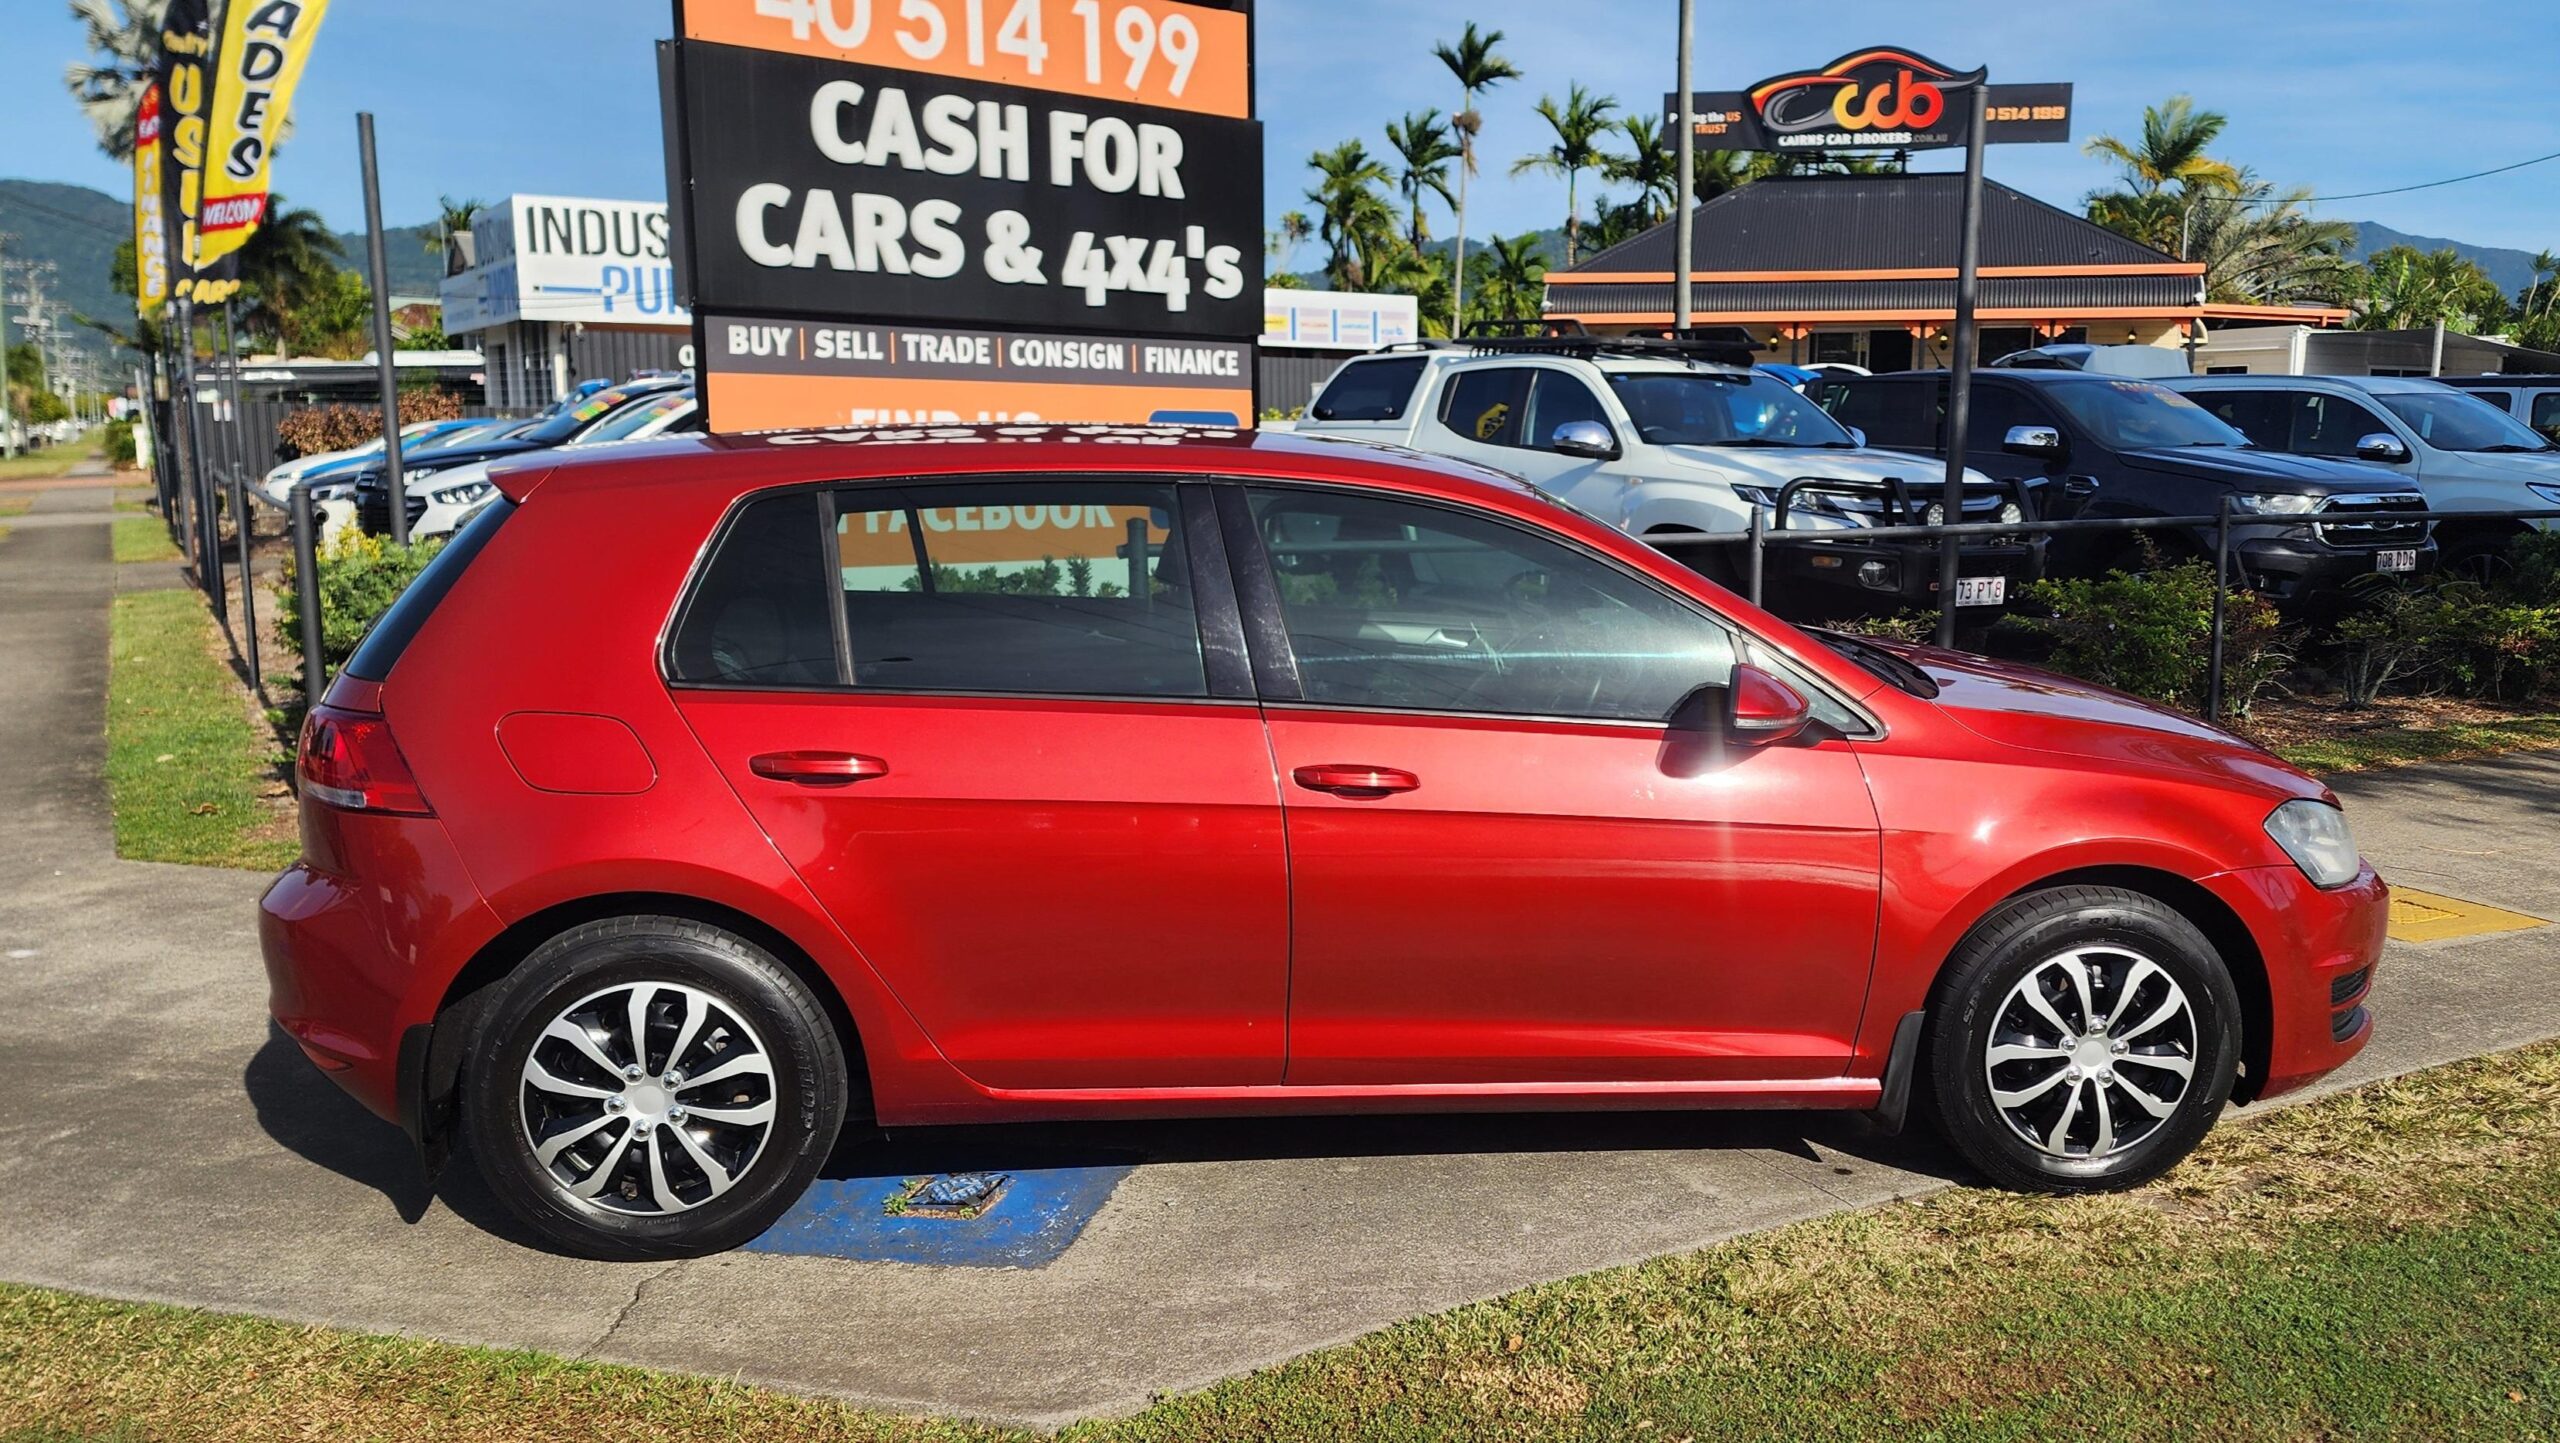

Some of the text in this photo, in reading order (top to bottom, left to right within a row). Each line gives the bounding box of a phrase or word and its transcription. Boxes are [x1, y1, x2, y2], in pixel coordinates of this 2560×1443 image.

[894, 0, 1049, 76] 514
[1073, 0, 1199, 98] 199
[1694, 123, 1728, 134] TRUST
[1726, 111, 1742, 122] US
[1997, 106, 2030, 120] 514
[809, 79, 1186, 199] CASH FOR
[1777, 134, 1825, 146] CAIRNS
[1825, 133, 1852, 145] CAR
[735, 182, 967, 279] CARS
[983, 209, 1048, 285] &
[728, 325, 792, 357] BUY
[814, 329, 884, 361] SELL
[902, 334, 991, 366] TRADE
[1010, 339, 1124, 371] CONSIGN
[1144, 346, 1240, 376] FINANCE
